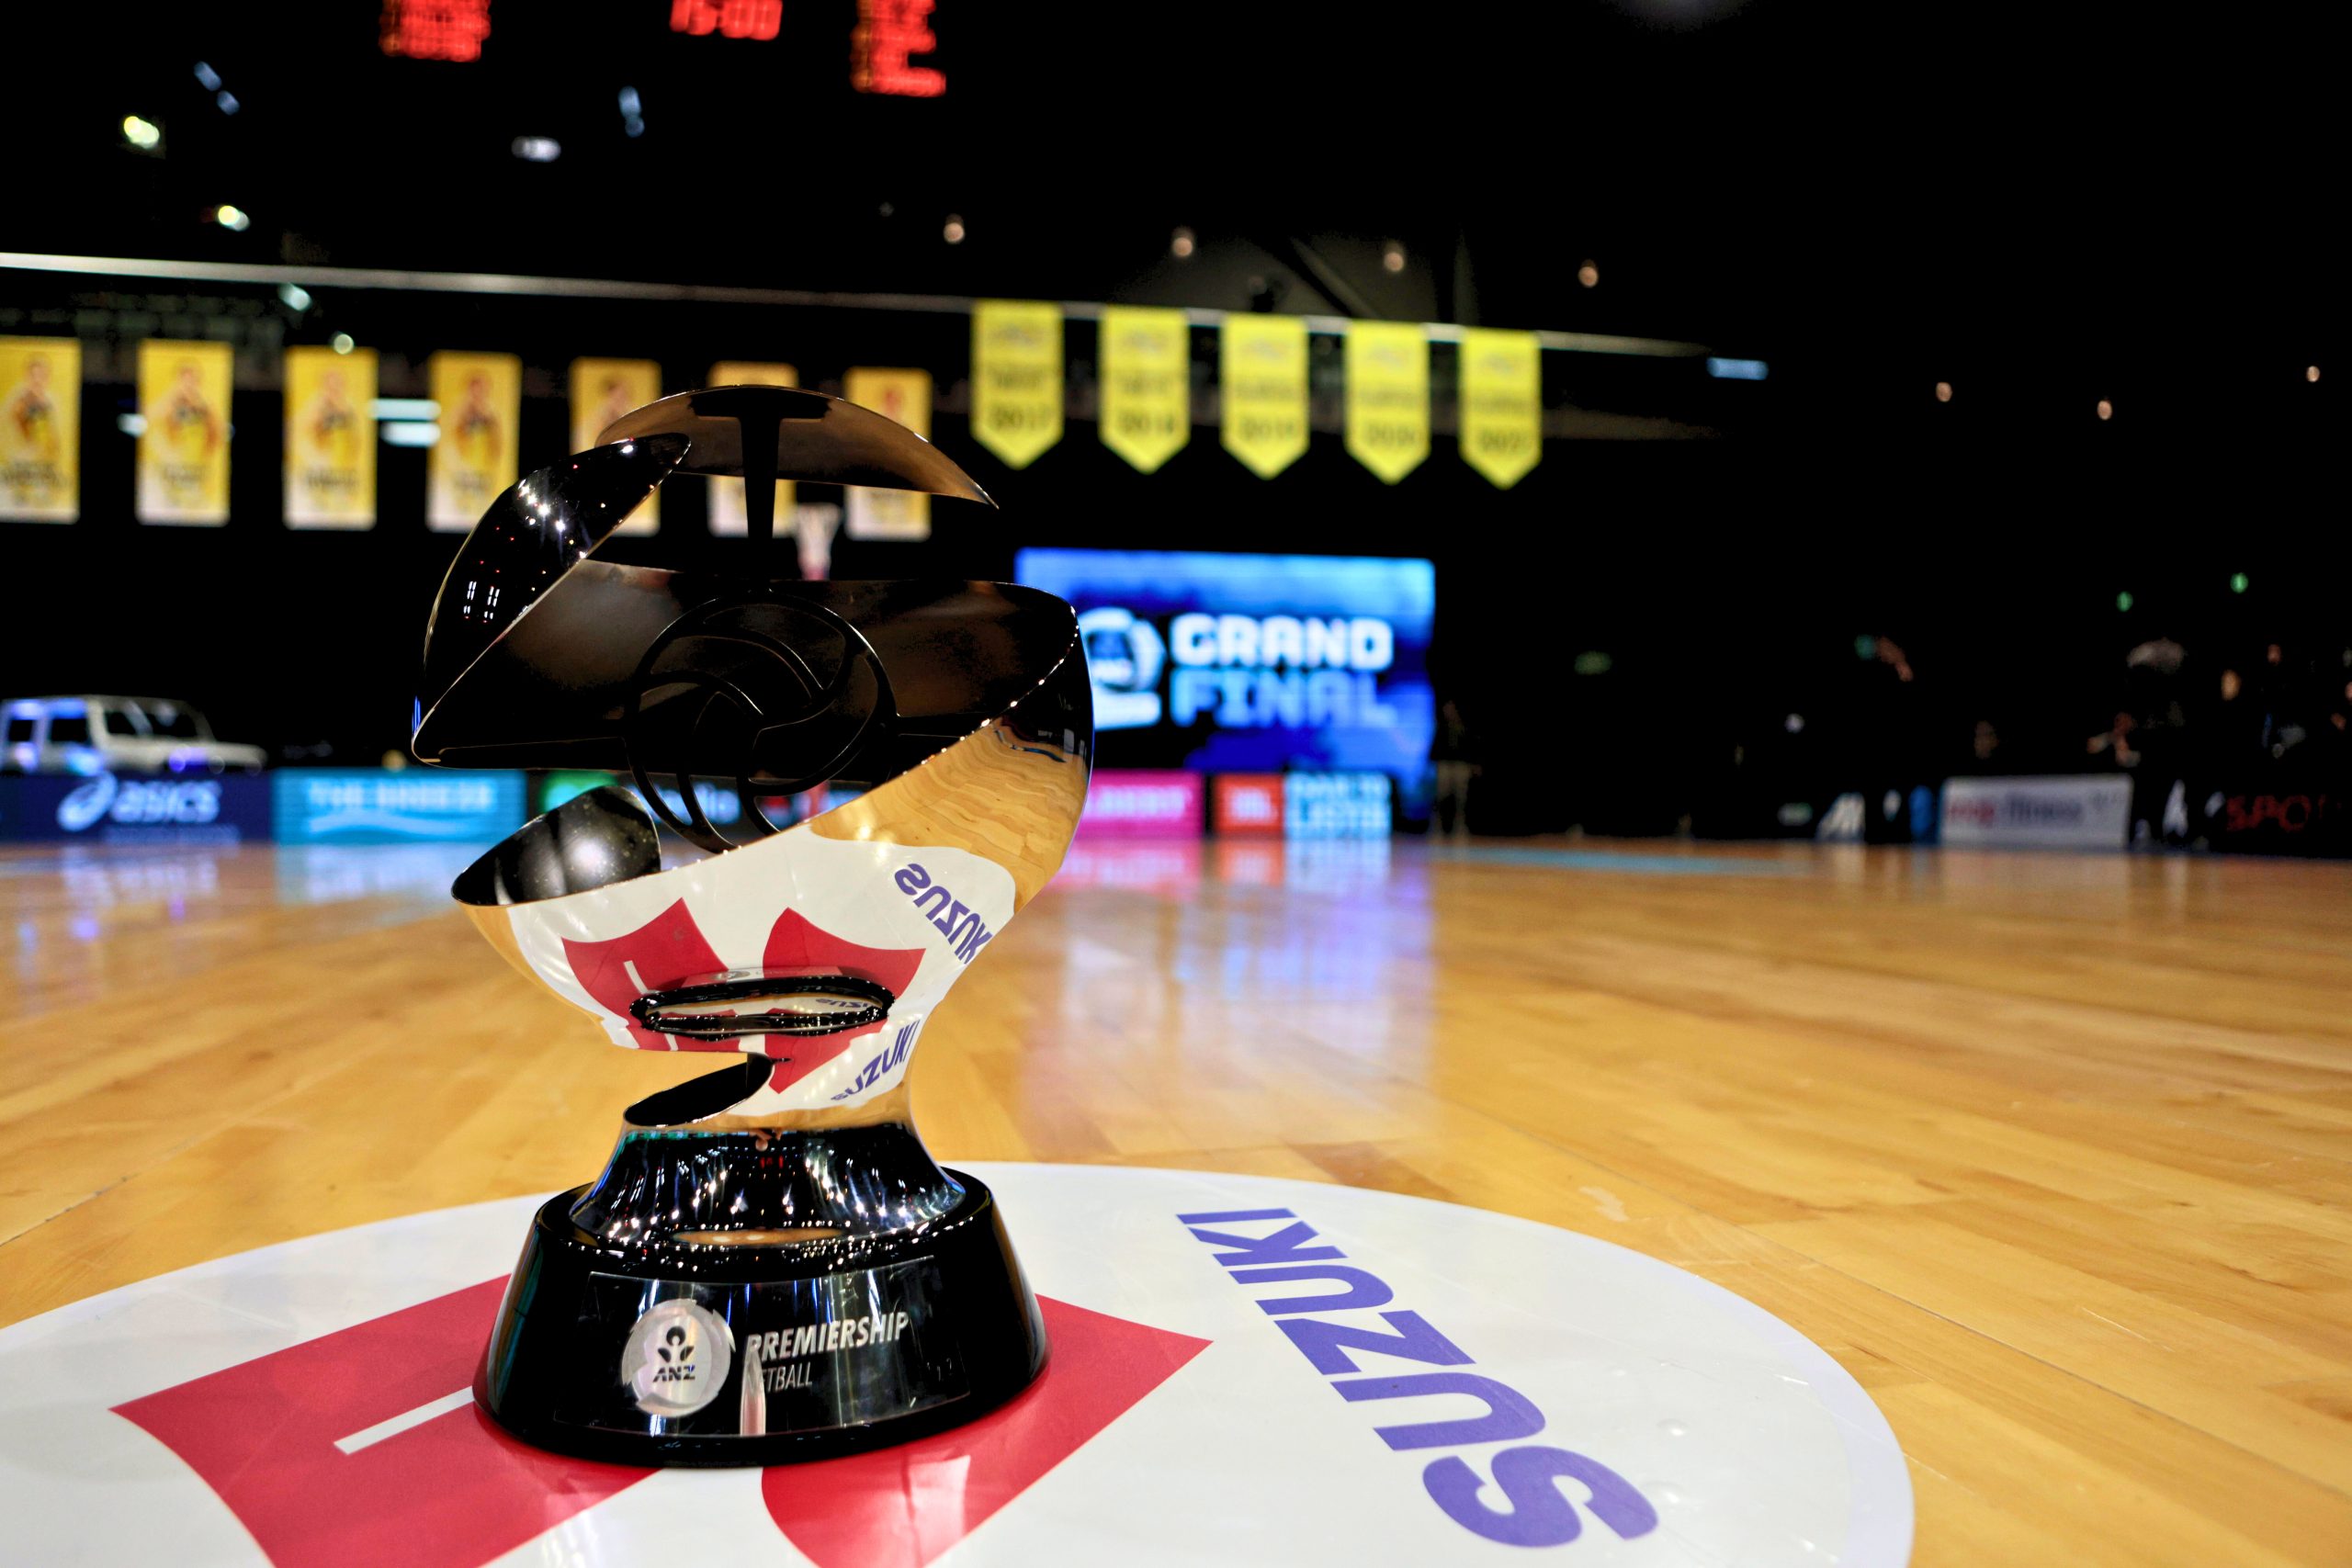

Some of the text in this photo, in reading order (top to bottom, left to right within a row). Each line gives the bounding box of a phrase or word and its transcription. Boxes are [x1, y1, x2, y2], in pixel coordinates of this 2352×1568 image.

[1170, 612, 1393, 671] GRAND
[1170, 668, 1397, 728] FINAL
[745, 1311, 910, 1363] PREMIERSHIP
[653, 1364, 696, 1382] ANZ
[1176, 1207, 1658, 1548] SUZUKI
